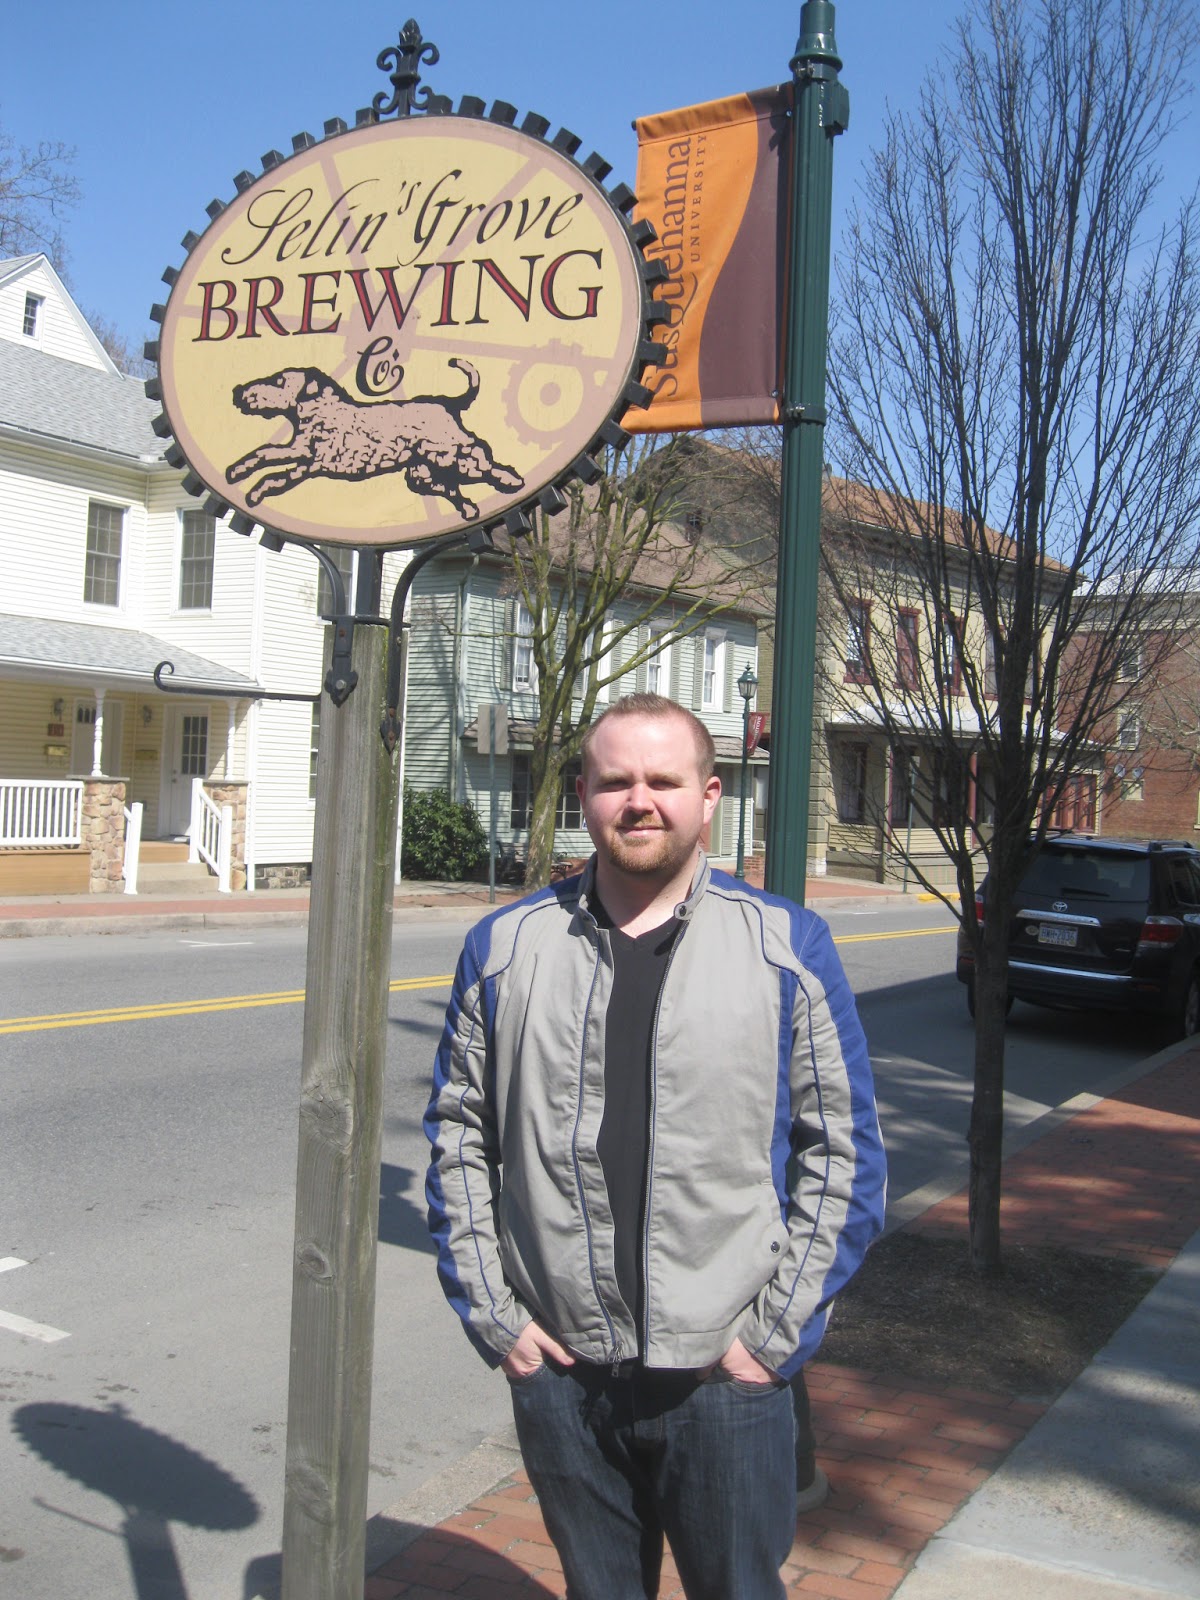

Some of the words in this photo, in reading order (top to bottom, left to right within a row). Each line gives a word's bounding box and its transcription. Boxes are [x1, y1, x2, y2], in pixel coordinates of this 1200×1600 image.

[221, 178, 421, 265] Selin's
[397, 169, 584, 266] Grove
[690, 134, 707, 263] UNIVERSITY
[192, 249, 604, 342] BREWING
